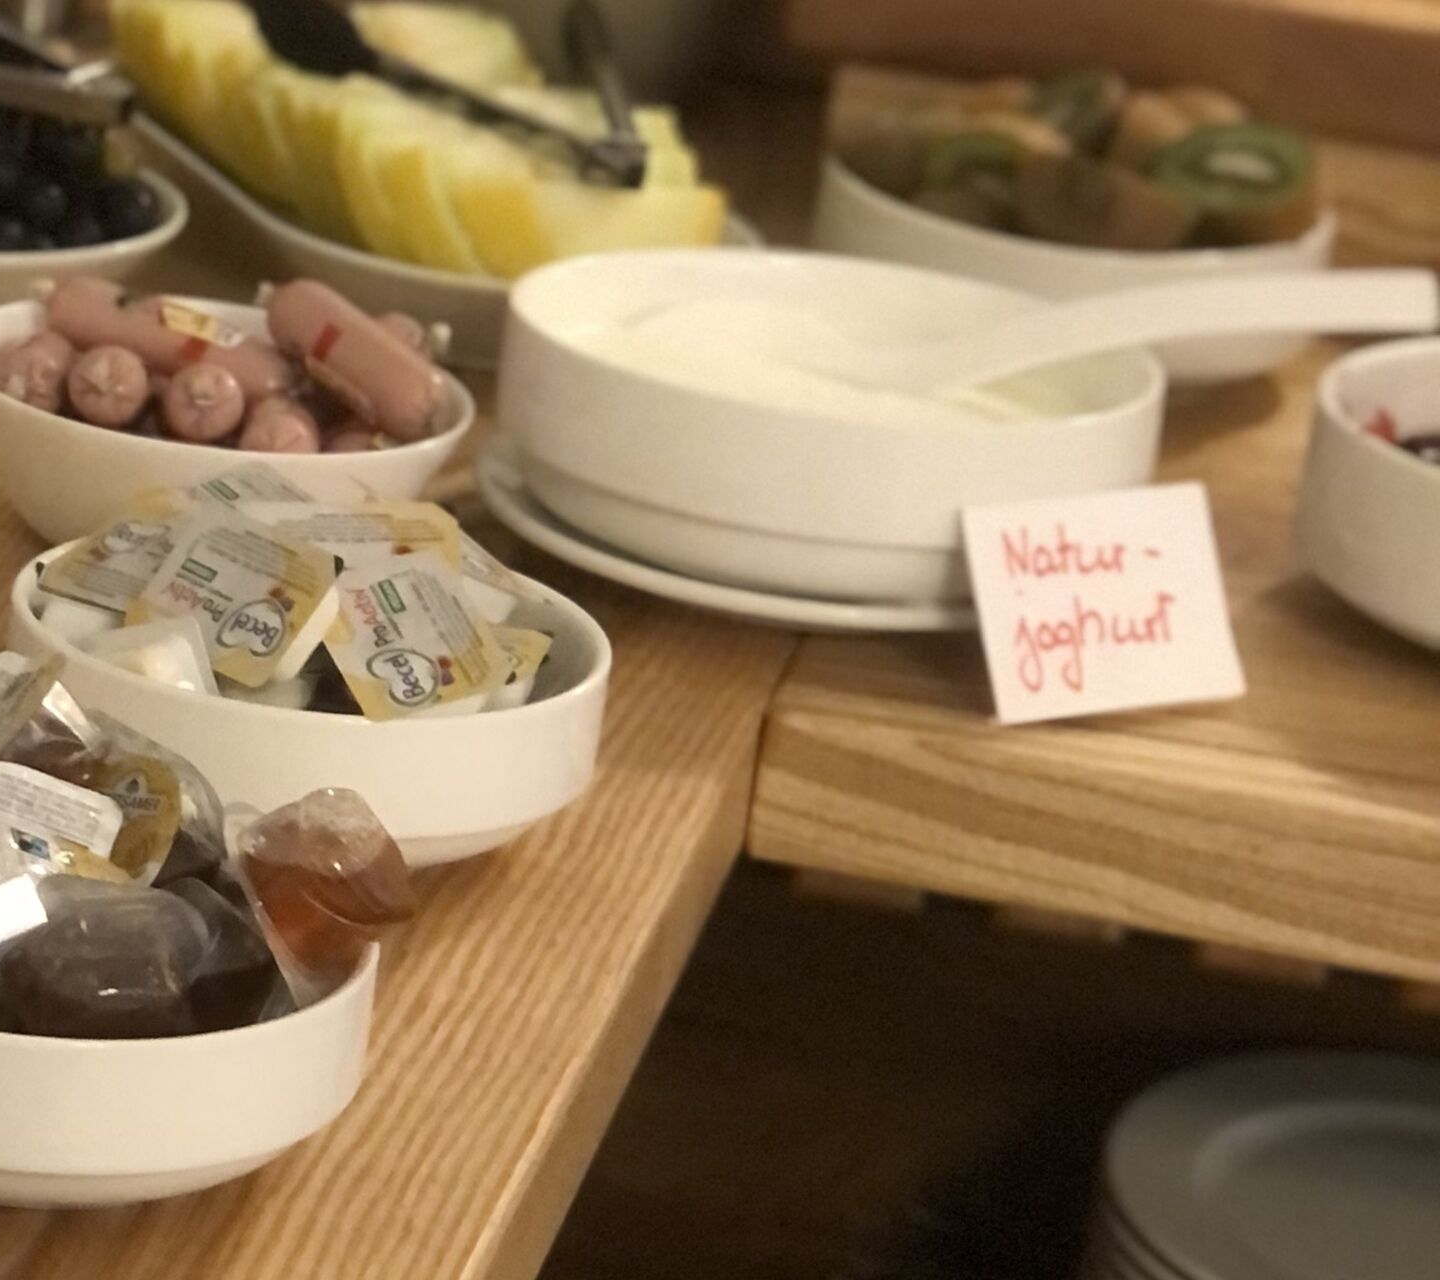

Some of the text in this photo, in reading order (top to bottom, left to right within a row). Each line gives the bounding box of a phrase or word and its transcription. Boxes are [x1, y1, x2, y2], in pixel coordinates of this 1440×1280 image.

[229, 612, 280, 649] Becel
[1013, 588, 1177, 693] joghurt
[382, 652, 427, 700] Becel
